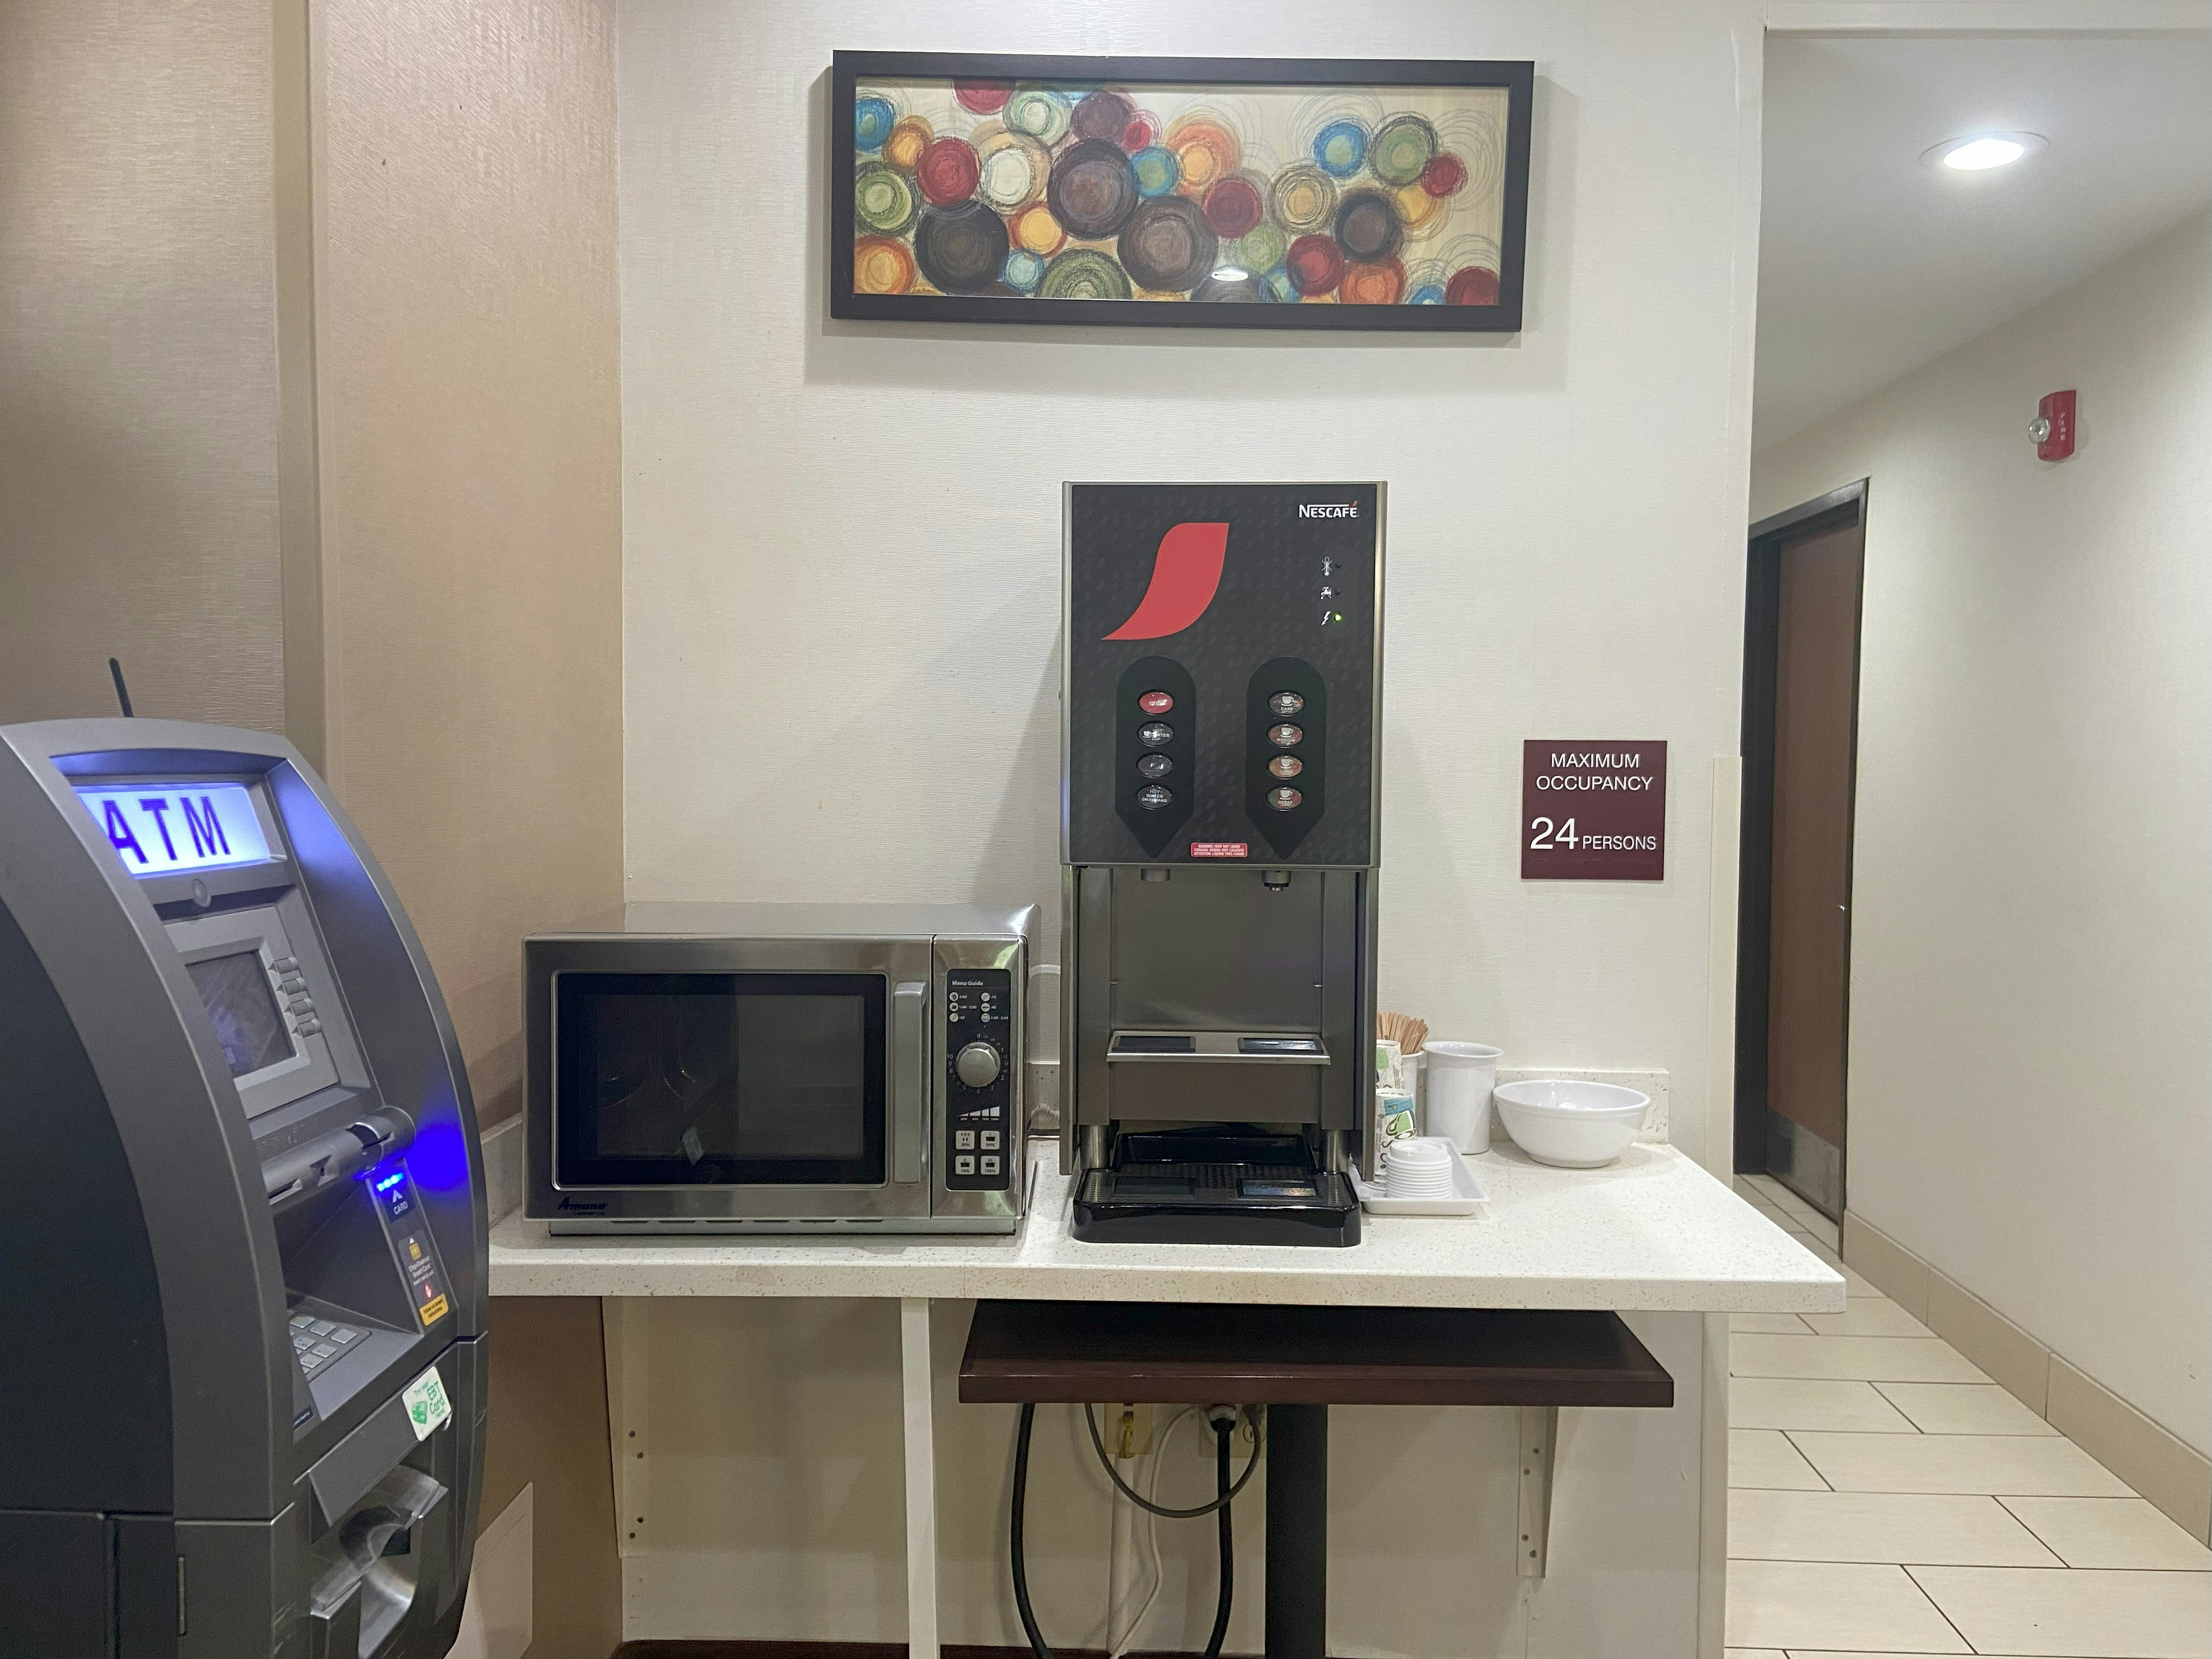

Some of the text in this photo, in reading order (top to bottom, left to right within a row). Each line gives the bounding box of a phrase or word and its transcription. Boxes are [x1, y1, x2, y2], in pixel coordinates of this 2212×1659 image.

[1551, 753, 1639, 768] MAXIMUM
[1536, 775, 1653, 791] OCCUPANCY
[101, 796, 232, 864] ATM
[1530, 816, 1656, 850] 24 PERSONS
[393, 1201, 408, 1215] CARD
[426, 1381, 440, 1401] EBT
[430, 1392, 444, 1414] Card
